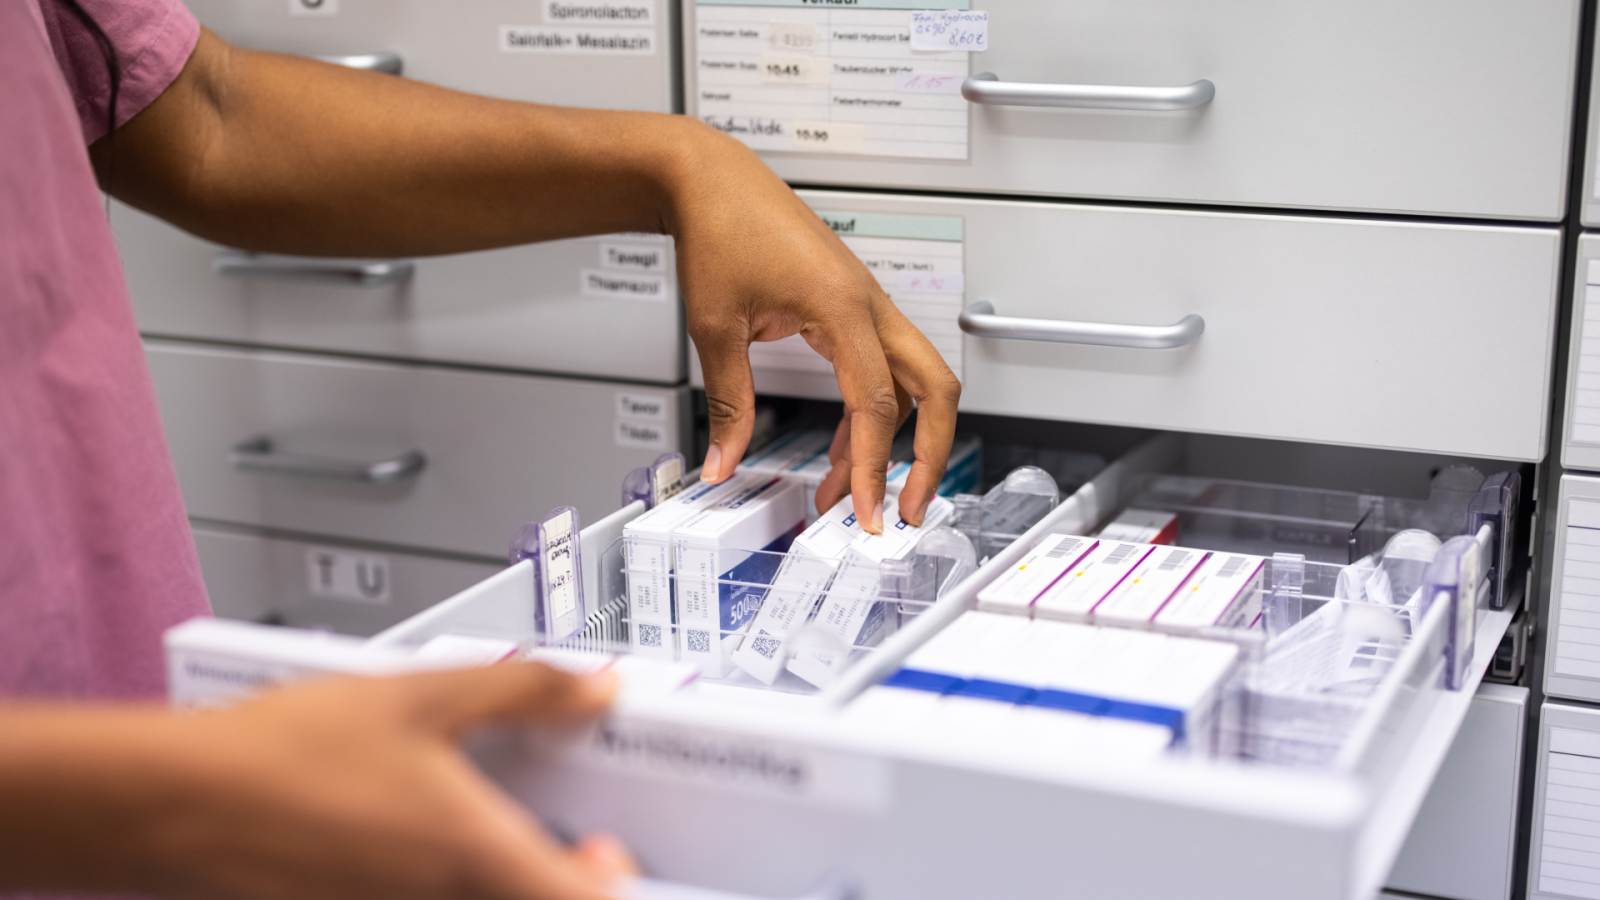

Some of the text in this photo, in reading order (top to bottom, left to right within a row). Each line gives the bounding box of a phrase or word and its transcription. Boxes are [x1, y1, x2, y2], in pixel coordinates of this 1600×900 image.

[549, 4, 649, 19] Spironolacton
[861, 33, 896, 42] Hydrocort
[356, 561, 385, 599] U
